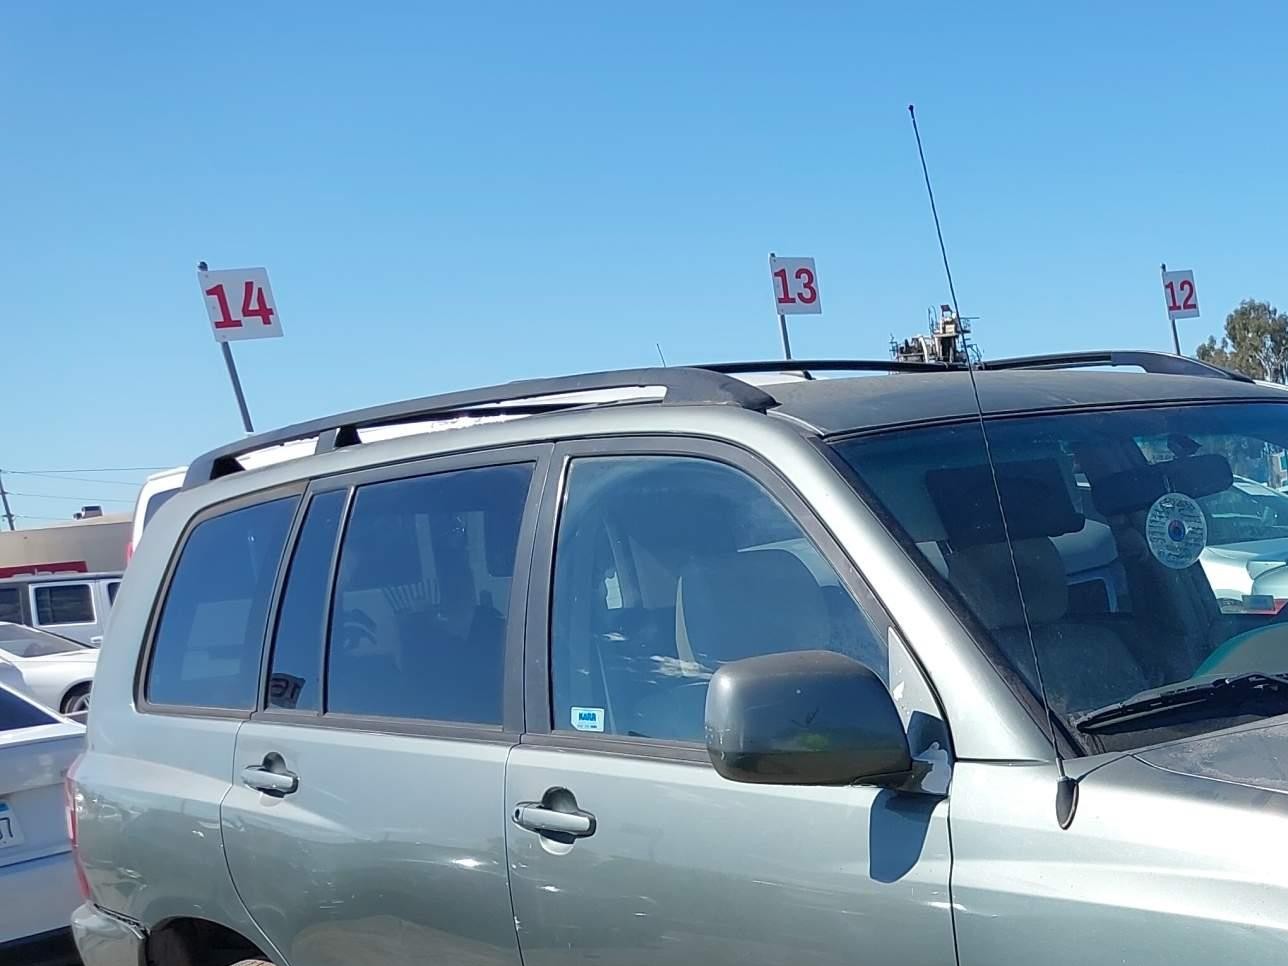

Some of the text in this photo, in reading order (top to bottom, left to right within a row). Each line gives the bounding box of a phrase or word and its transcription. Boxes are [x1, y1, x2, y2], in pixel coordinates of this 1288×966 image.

[206, 281, 273, 329] 14
[775, 269, 816, 305] 13
[1165, 279, 1194, 311] 12
